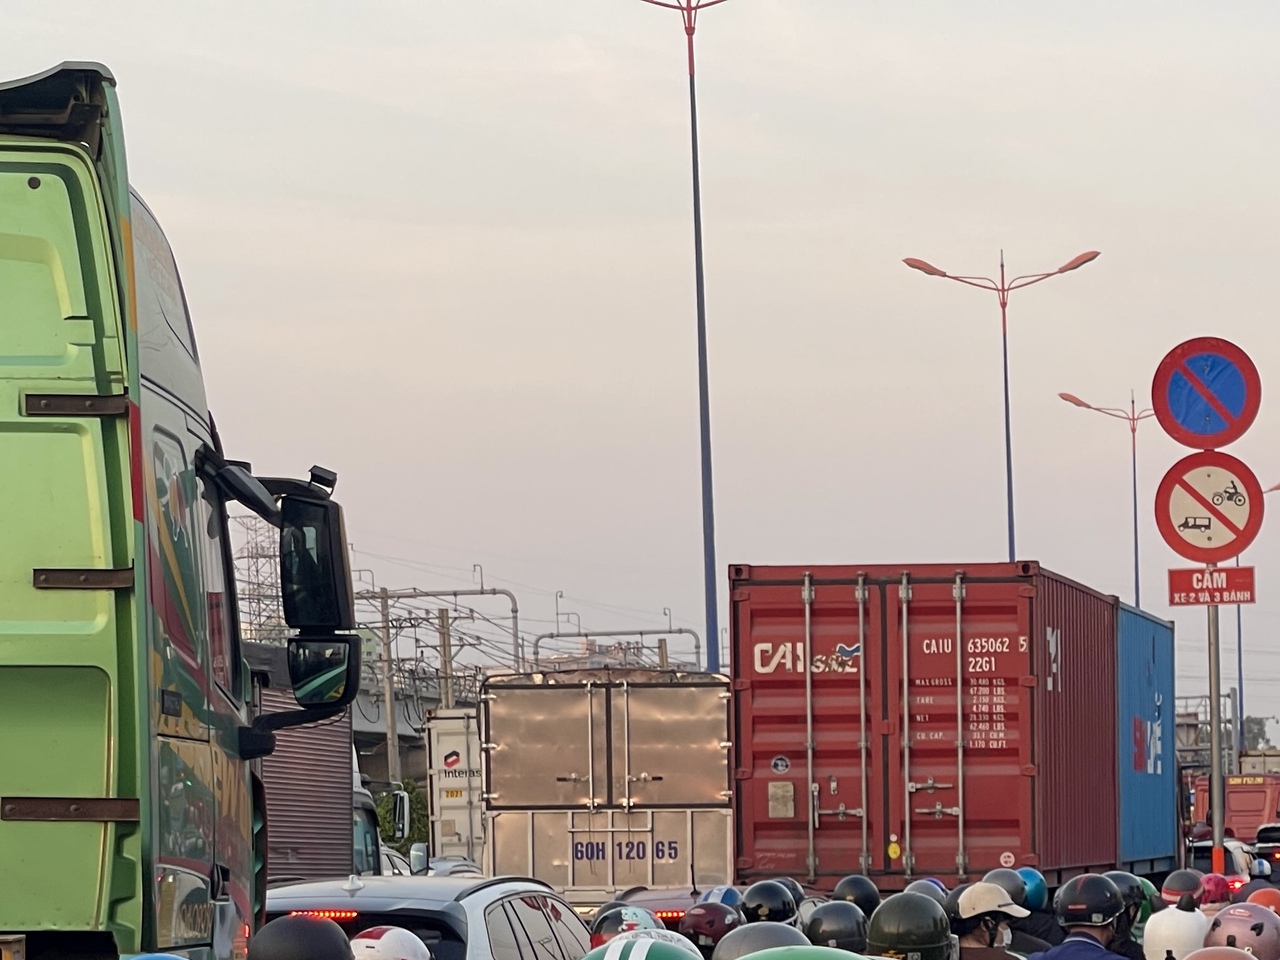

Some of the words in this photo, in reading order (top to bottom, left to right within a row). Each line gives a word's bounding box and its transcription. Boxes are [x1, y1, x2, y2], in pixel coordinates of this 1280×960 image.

[1174, 593, 1186, 603] XE
[1189, 592, 1196, 602] 2
[1199, 590, 1211, 602] VÀ
[1214, 592, 1220, 602] 3
[1223, 589, 1250, 601] BÁNH
[923, 638, 952, 653] CAIU
[967, 638, 1010, 653] 635062
[1020, 637, 1027, 652] 5
[754, 642, 804, 673] CAI
[968, 657, 996, 672] 22G1
[444, 769, 482, 778] Interas
[575, 841, 606, 860] 60H
[616, 841, 646, 860] 120
[655, 841, 678, 860] 65
